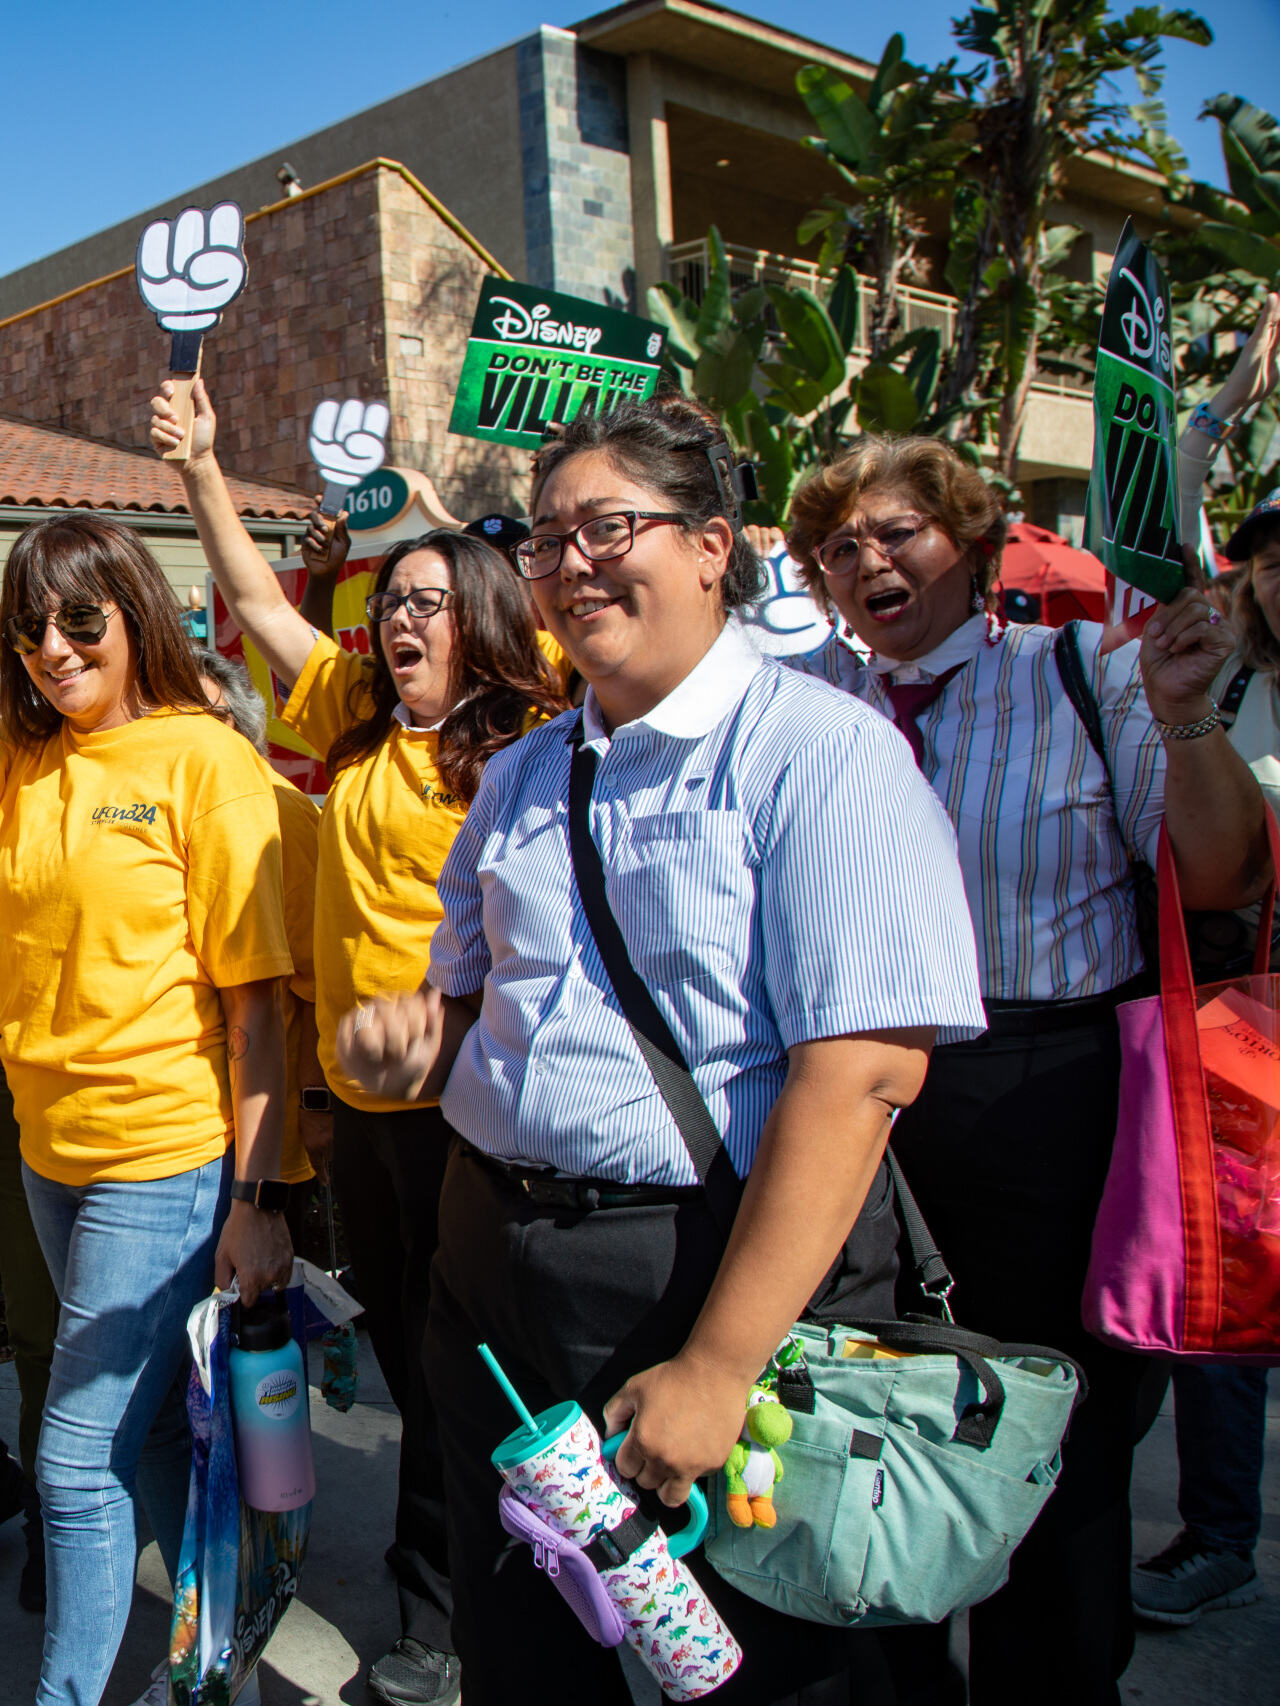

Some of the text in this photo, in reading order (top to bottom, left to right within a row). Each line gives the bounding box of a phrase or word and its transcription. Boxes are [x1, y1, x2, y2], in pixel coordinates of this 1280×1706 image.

[488, 352, 650, 393] DON'T BE THE
[345, 486, 393, 514] 1610
